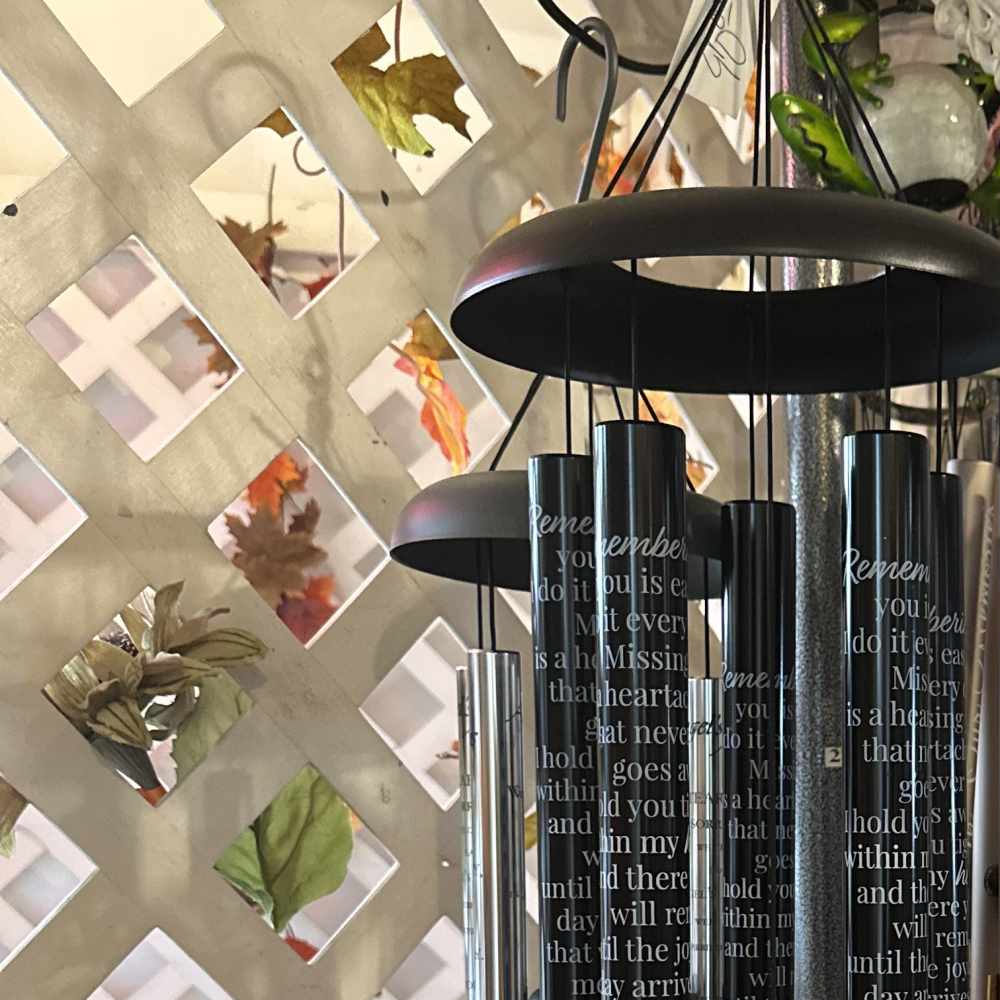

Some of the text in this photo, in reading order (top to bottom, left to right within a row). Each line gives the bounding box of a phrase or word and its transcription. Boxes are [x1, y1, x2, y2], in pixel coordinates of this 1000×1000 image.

[539, 578, 590, 601] do it
[642, 568, 662, 594] is
[604, 608, 620, 632] it
[875, 596, 919, 622] you
[852, 628, 909, 653] do it
[536, 647, 568, 670] is a
[846, 703, 881, 727] is a
[747, 728, 763, 749] it
[864, 739, 911, 762] that
[543, 745, 593, 768] hold
[829, 751, 841, 763] 2
[613, 758, 671, 785] goes
[628, 799, 674, 822] you
[853, 808, 905, 834] hold
[549, 811, 592, 835] and
[728, 819, 768, 840] that
[640, 835, 678, 860] my
[542, 876, 592, 900] until
[626, 866, 687, 890] there
[857, 879, 903, 904] and
[557, 909, 599, 936] day
[611, 901, 656, 926] will
[547, 941, 592, 963] that
[625, 936, 668, 962] the
[724, 937, 758, 958] and
[848, 949, 900, 975] until
